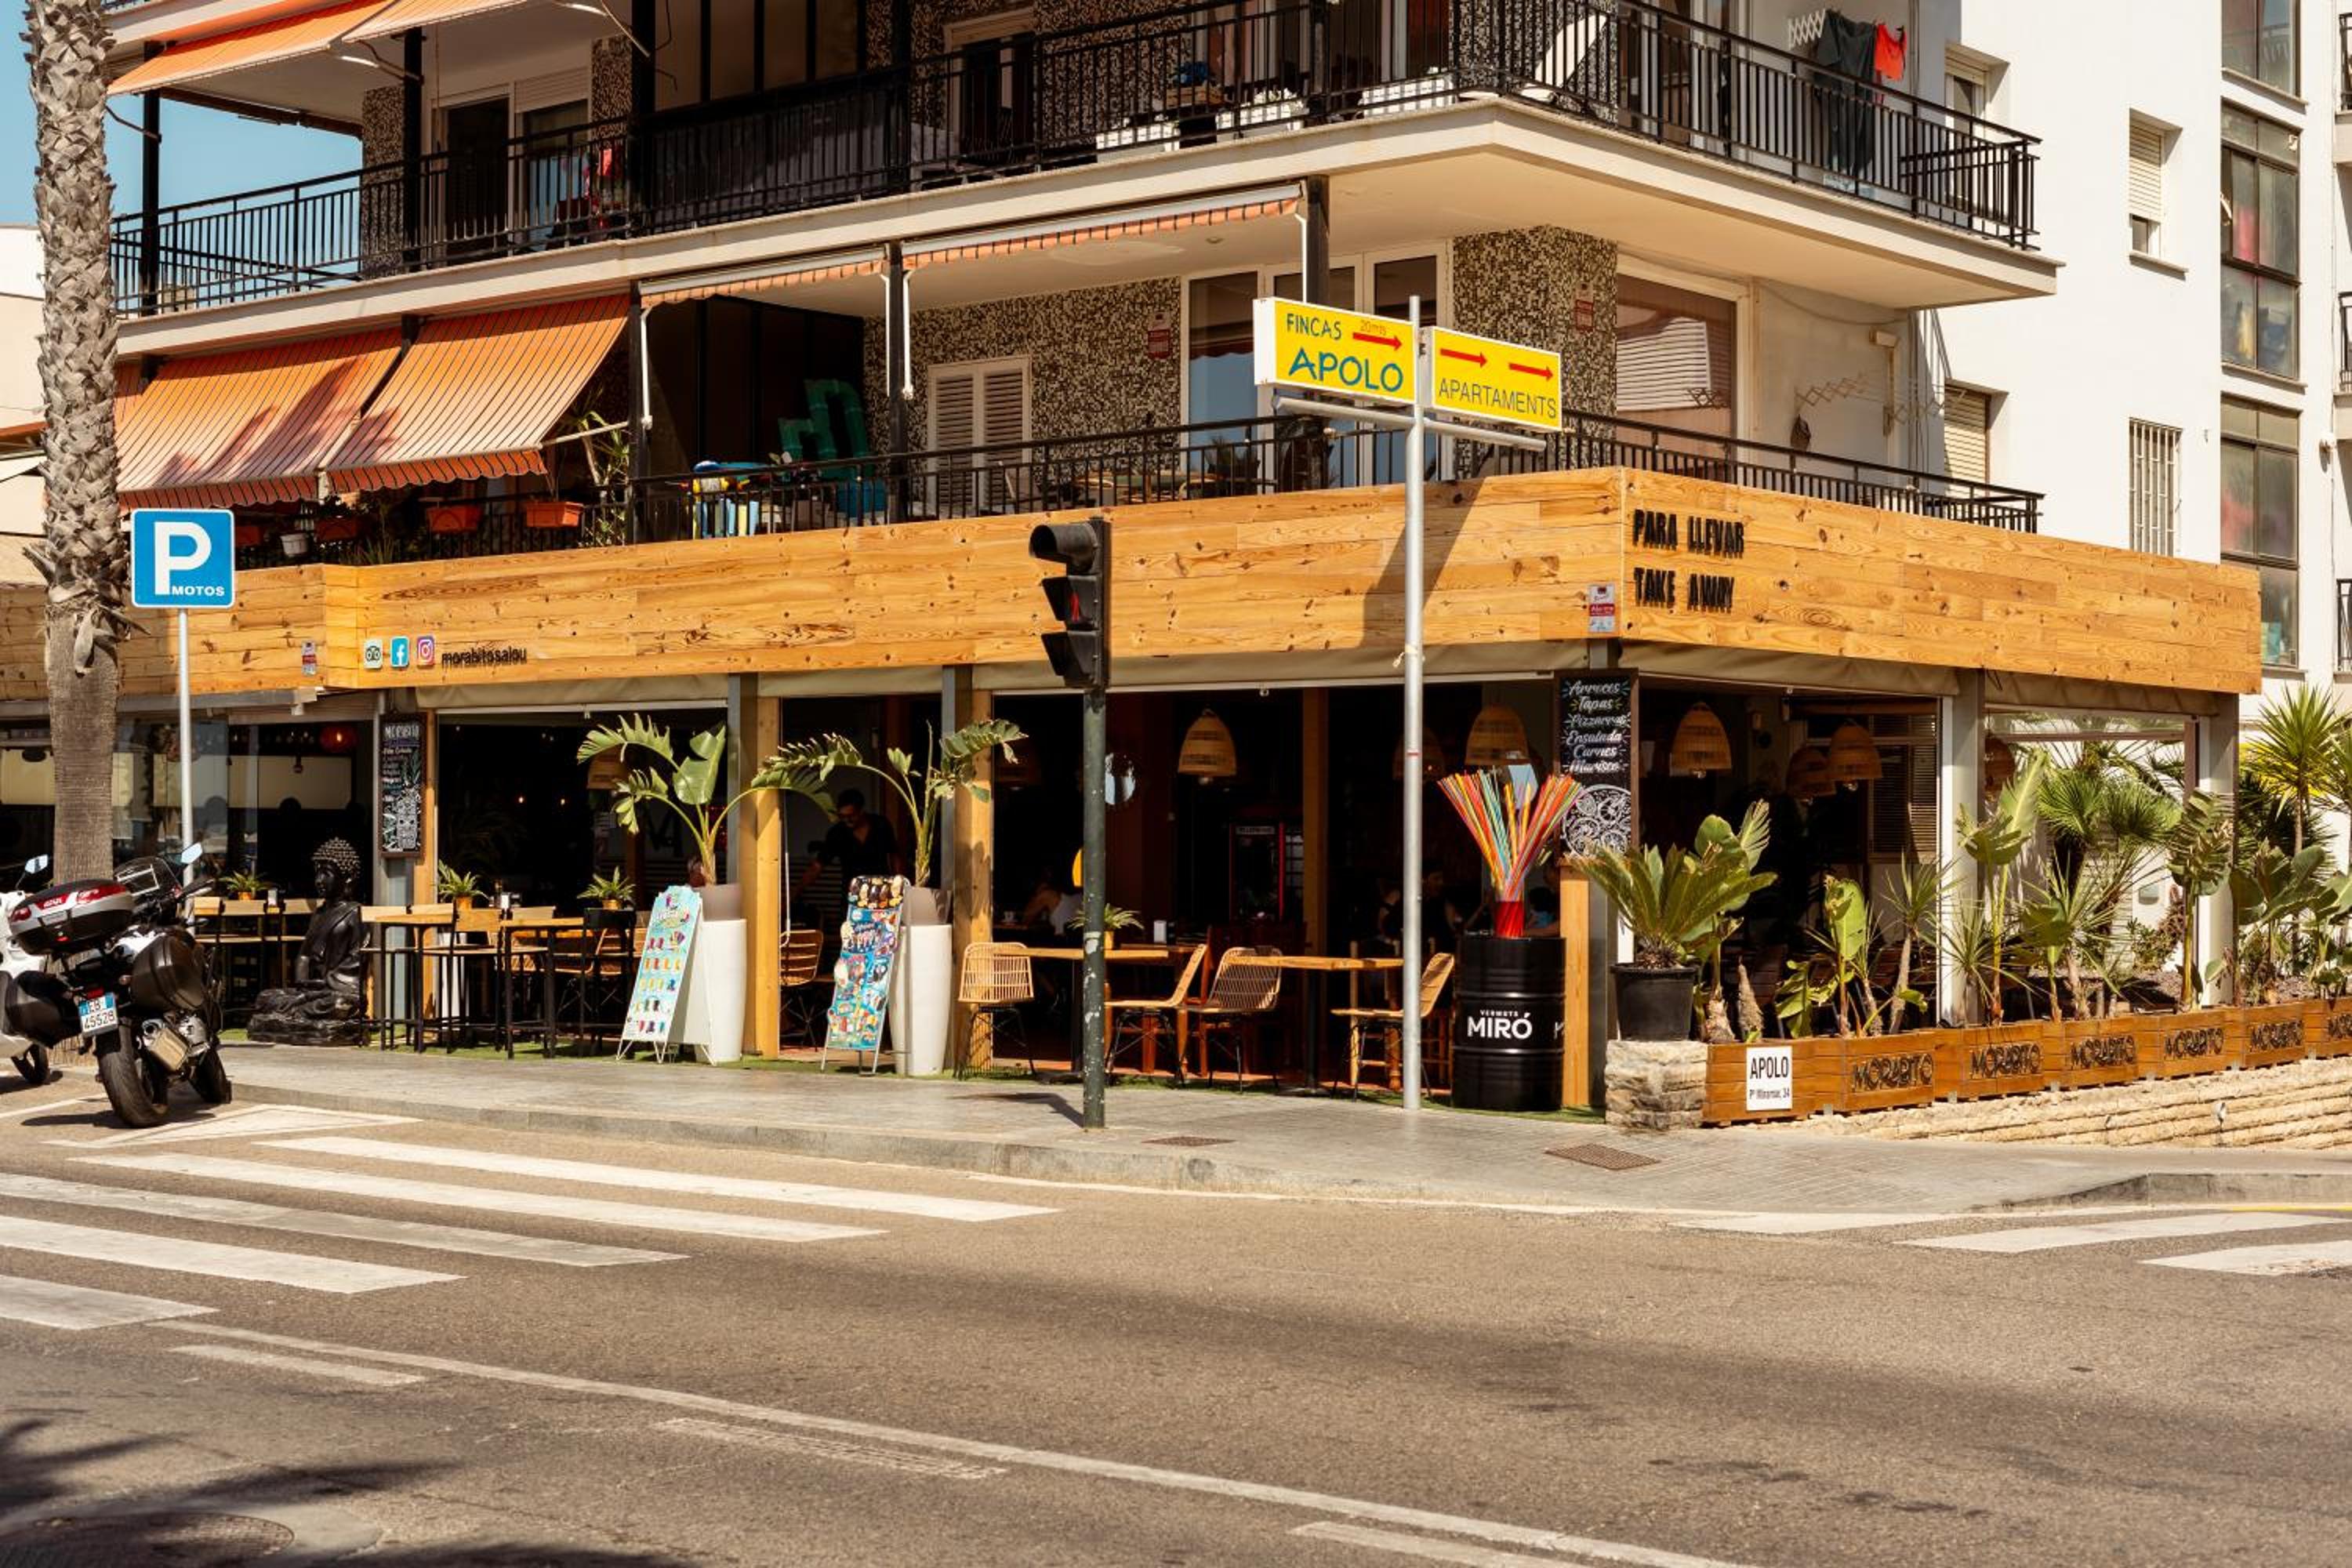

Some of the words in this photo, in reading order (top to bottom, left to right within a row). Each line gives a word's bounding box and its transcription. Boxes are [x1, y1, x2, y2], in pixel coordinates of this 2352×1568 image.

[1287, 313, 1342, 341] FINCAS
[1288, 347, 1403, 393] APOLO
[1439, 378, 1557, 420] APARTAMENTS
[1633, 509, 1679, 550] PARA
[1687, 515, 1744, 559] LLEVAR
[154, 521, 212, 595] P
[172, 586, 225, 597] MOTOS
[1633, 567, 1675, 608] TAKE
[1687, 573, 1735, 614] AWAY
[441, 646, 527, 669] morabitosalou
[1579, 696, 1614, 713] Tapas
[1467, 1011, 1533, 1040] MIRÓ
[1749, 1055, 1790, 1079] APOLO
